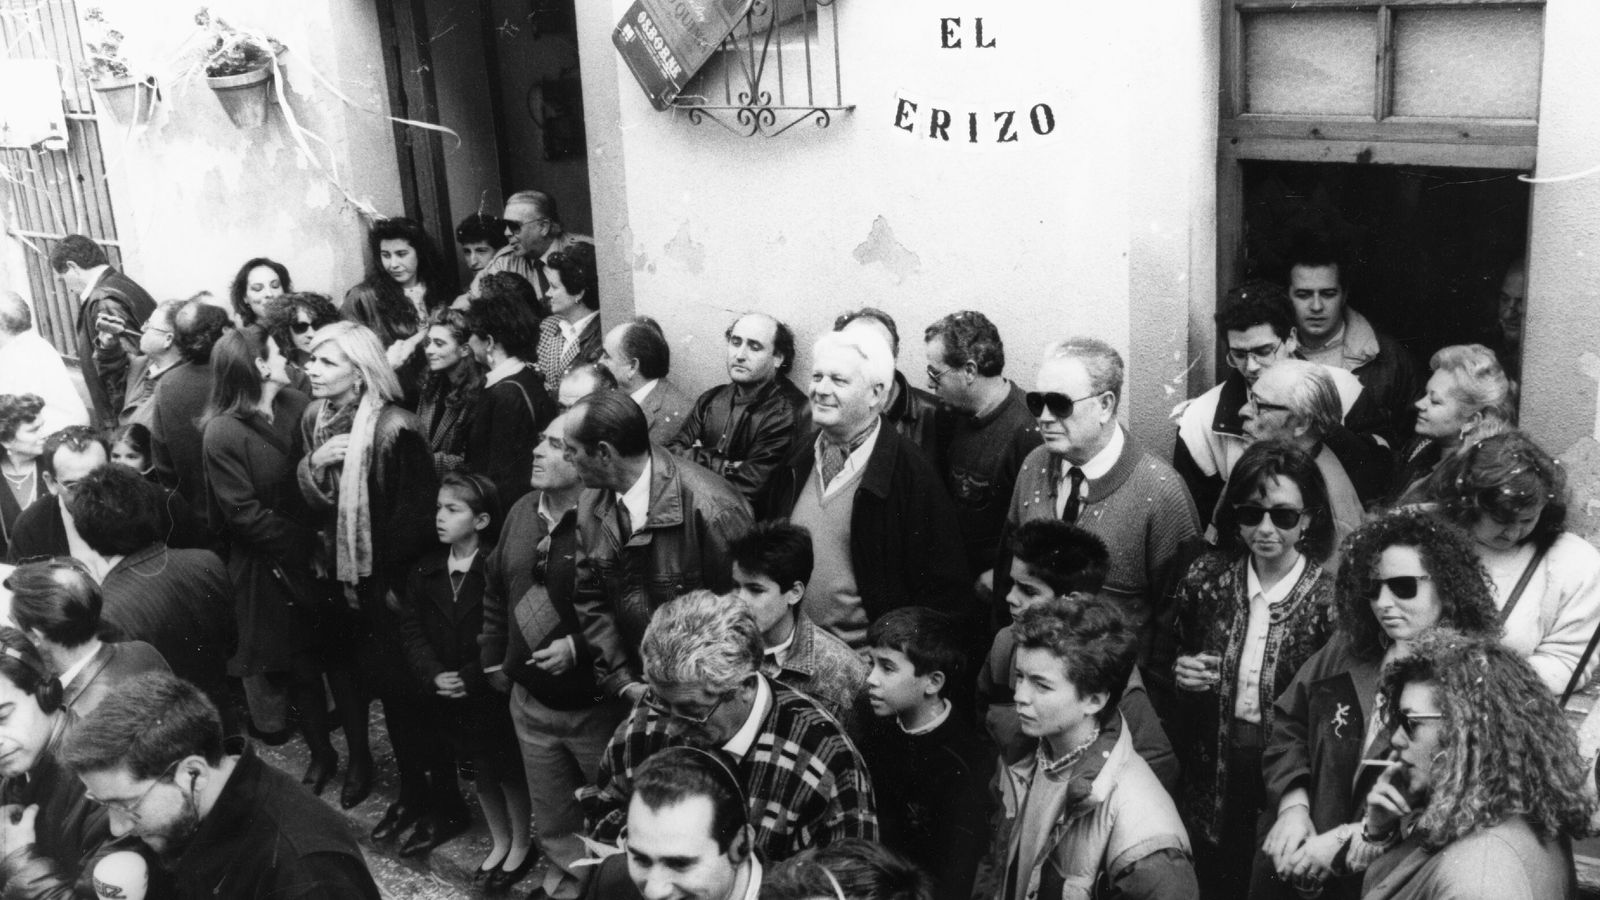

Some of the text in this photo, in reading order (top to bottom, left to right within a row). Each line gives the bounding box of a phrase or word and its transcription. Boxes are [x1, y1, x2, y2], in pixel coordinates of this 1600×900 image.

[637, 11, 682, 79] OSBORNE
[940, 17, 996, 49] EL
[894, 97, 1055, 143] ERIZO
